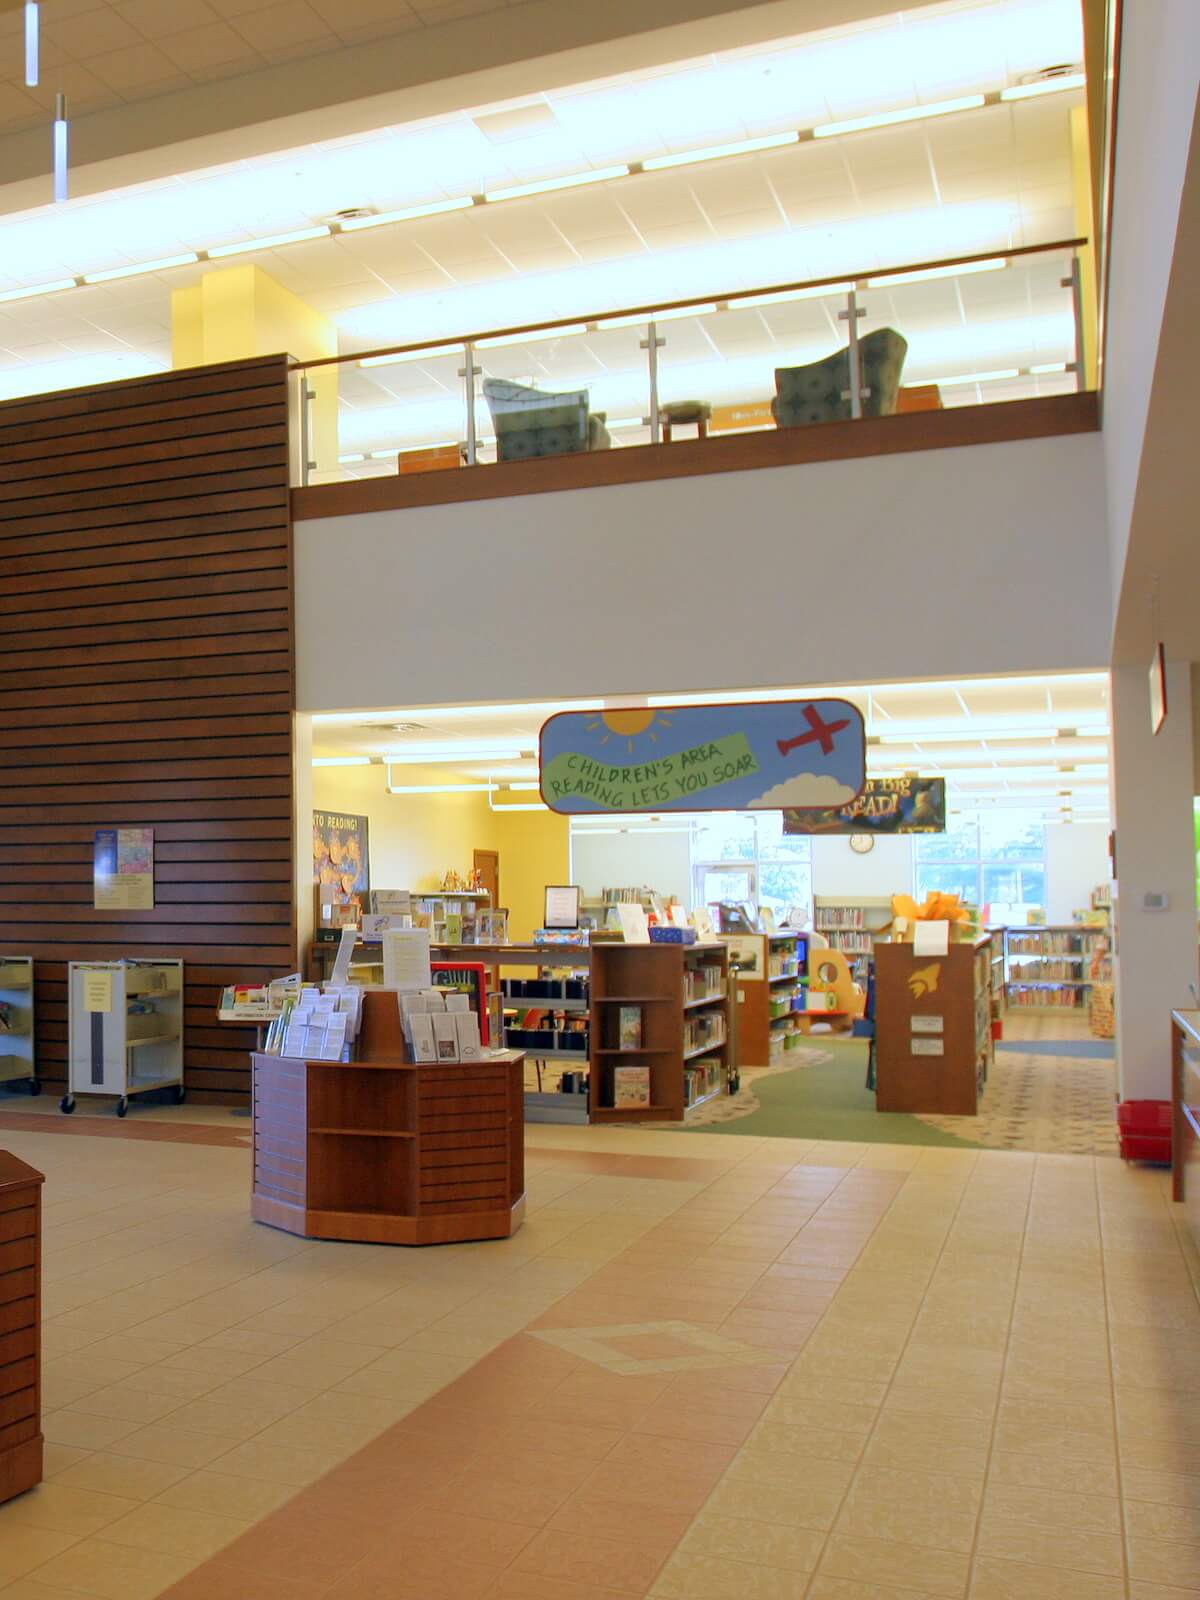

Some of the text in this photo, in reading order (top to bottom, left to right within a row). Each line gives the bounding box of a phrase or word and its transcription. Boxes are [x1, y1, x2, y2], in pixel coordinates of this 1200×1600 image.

[551, 753, 757, 808] READING LETS YOU SOAR
[567, 744, 722, 784] CHILDREN'S AREA
